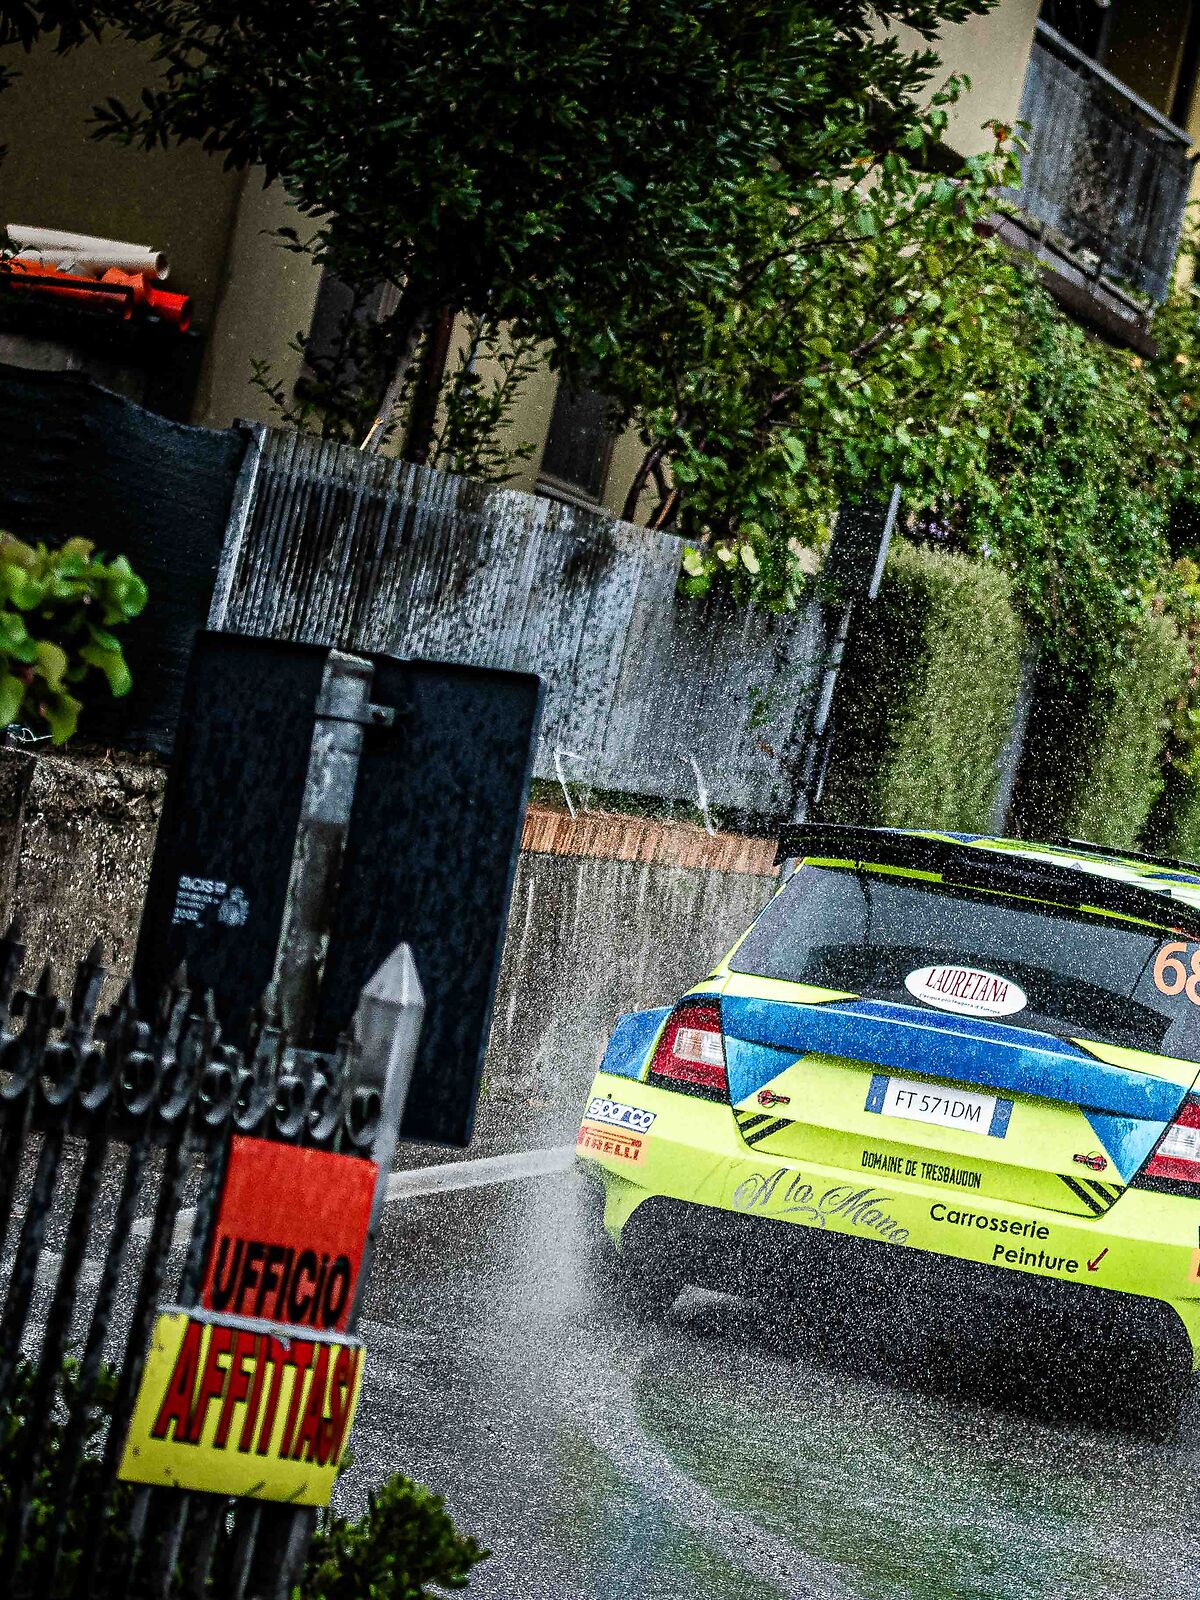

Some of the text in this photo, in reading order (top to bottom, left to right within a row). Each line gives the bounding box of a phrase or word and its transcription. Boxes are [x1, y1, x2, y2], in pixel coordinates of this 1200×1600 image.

[924, 968, 1009, 1002] LAURETANA
[587, 1099, 656, 1128] sparco
[895, 1090, 982, 1123] FT 571DM
[861, 1150, 982, 1189] DOMAINE DE TRESBAUDON
[930, 1203, 1050, 1240] Carrosserie
[992, 1244, 1079, 1273] Peinture
[212, 1238, 350, 1327] UFFICIO
